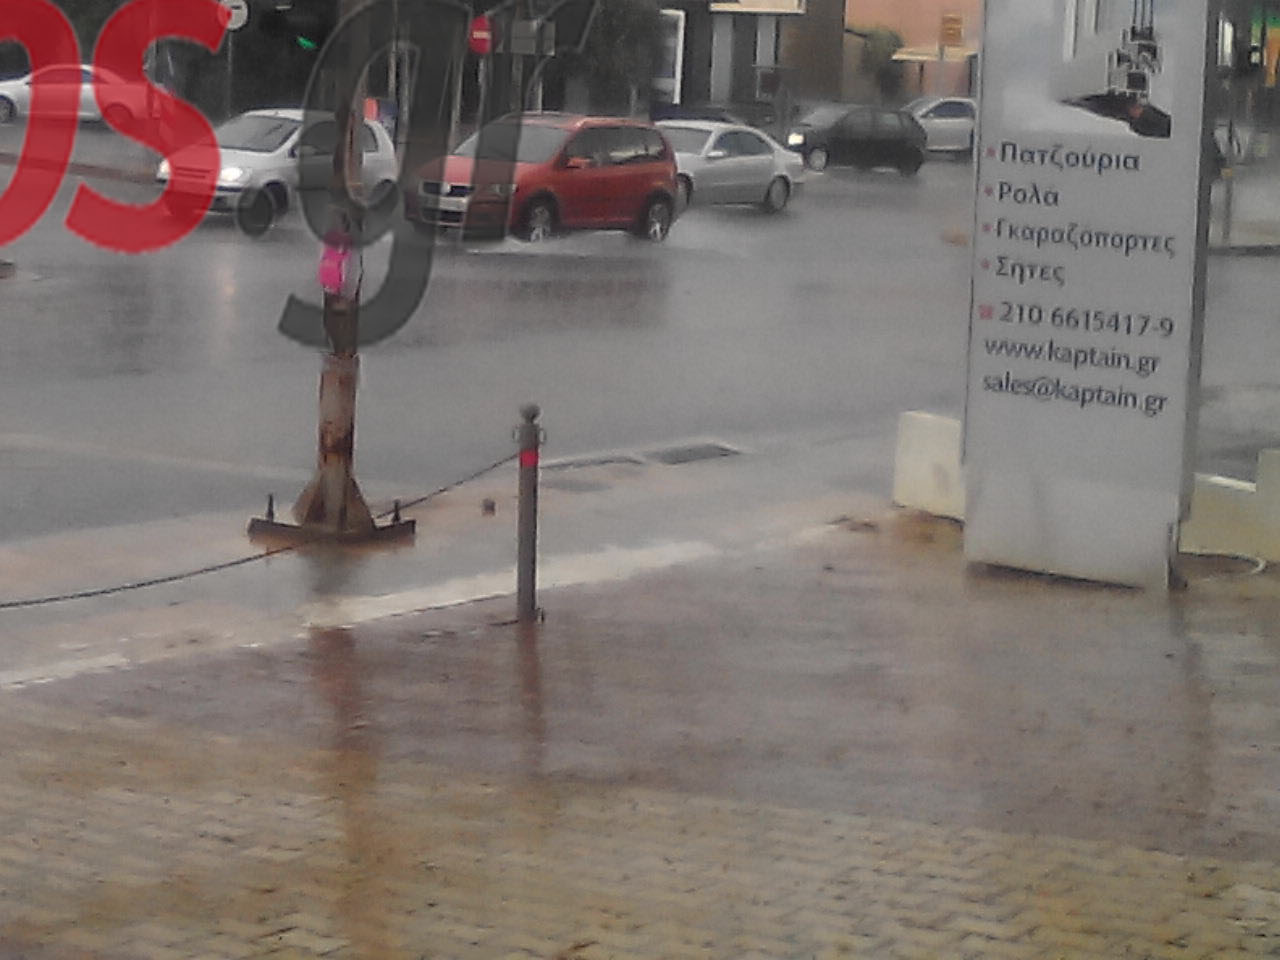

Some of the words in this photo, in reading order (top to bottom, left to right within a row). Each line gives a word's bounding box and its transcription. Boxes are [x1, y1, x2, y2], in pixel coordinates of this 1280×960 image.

[1001, 141, 1141, 175] Πατζούρια
[1000, 301, 1043, 325] 210
[1051, 307, 1174, 337] 6615417-9
[985, 339, 1161, 378] www.kaptain.gr
[983, 371, 1168, 417] sales@kaptain.gr
